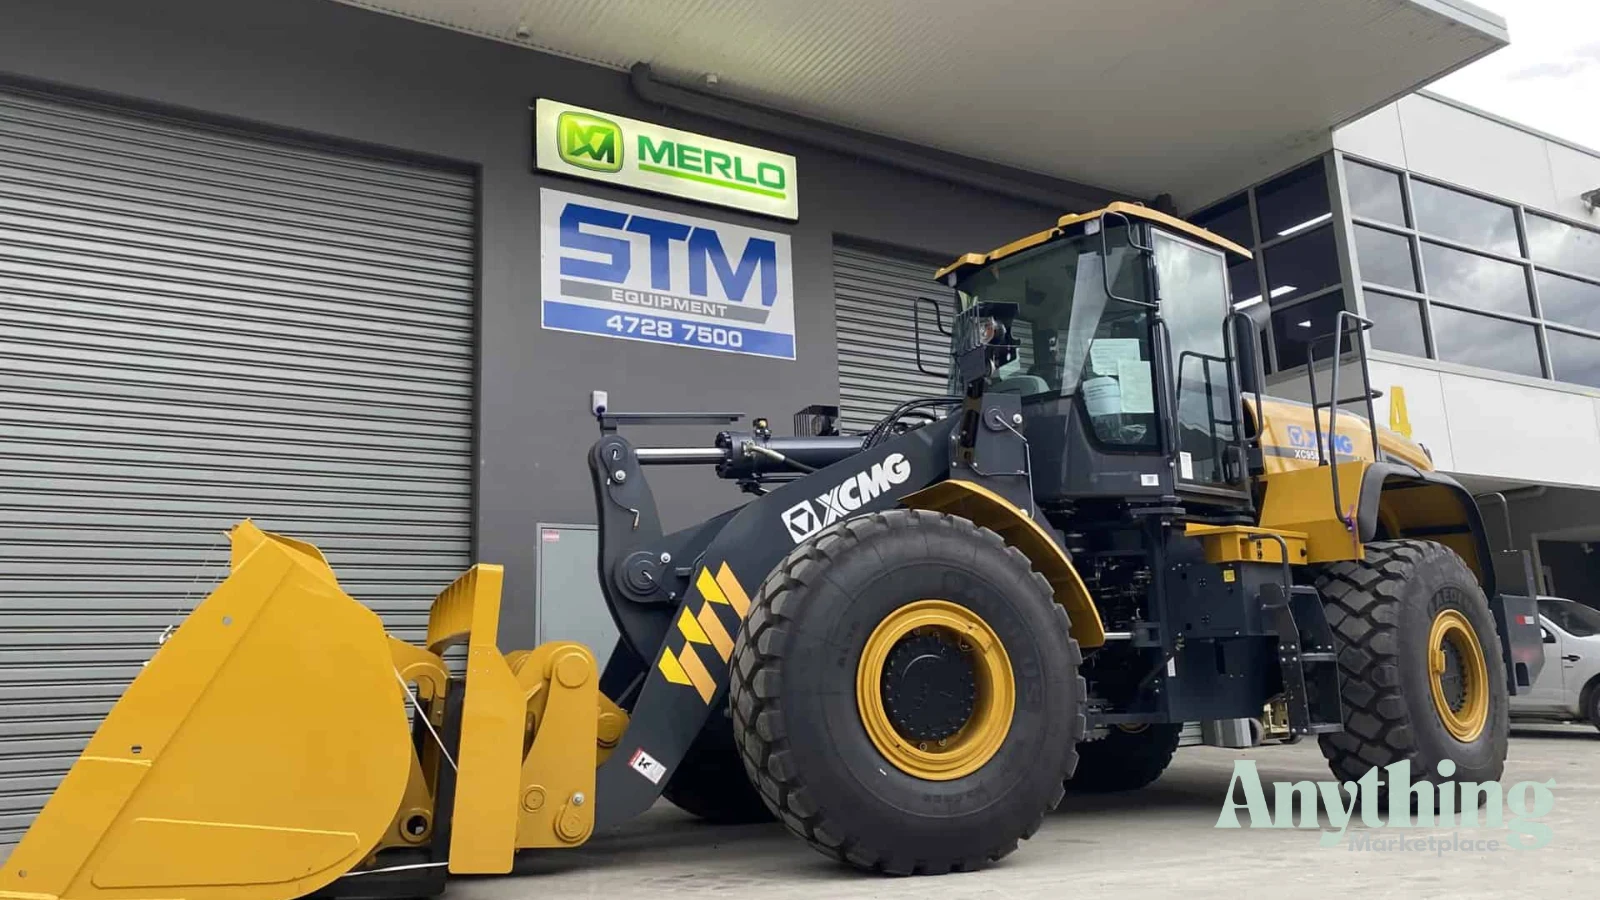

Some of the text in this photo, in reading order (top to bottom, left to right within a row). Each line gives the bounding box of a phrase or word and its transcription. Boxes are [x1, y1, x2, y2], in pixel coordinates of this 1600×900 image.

[637, 134, 786, 190] MERLO
[559, 202, 778, 307] STM
[611, 289, 728, 317] EQUIPMENT
[606, 315, 743, 348] 4728 7500
[815, 453, 911, 528] XCMG
